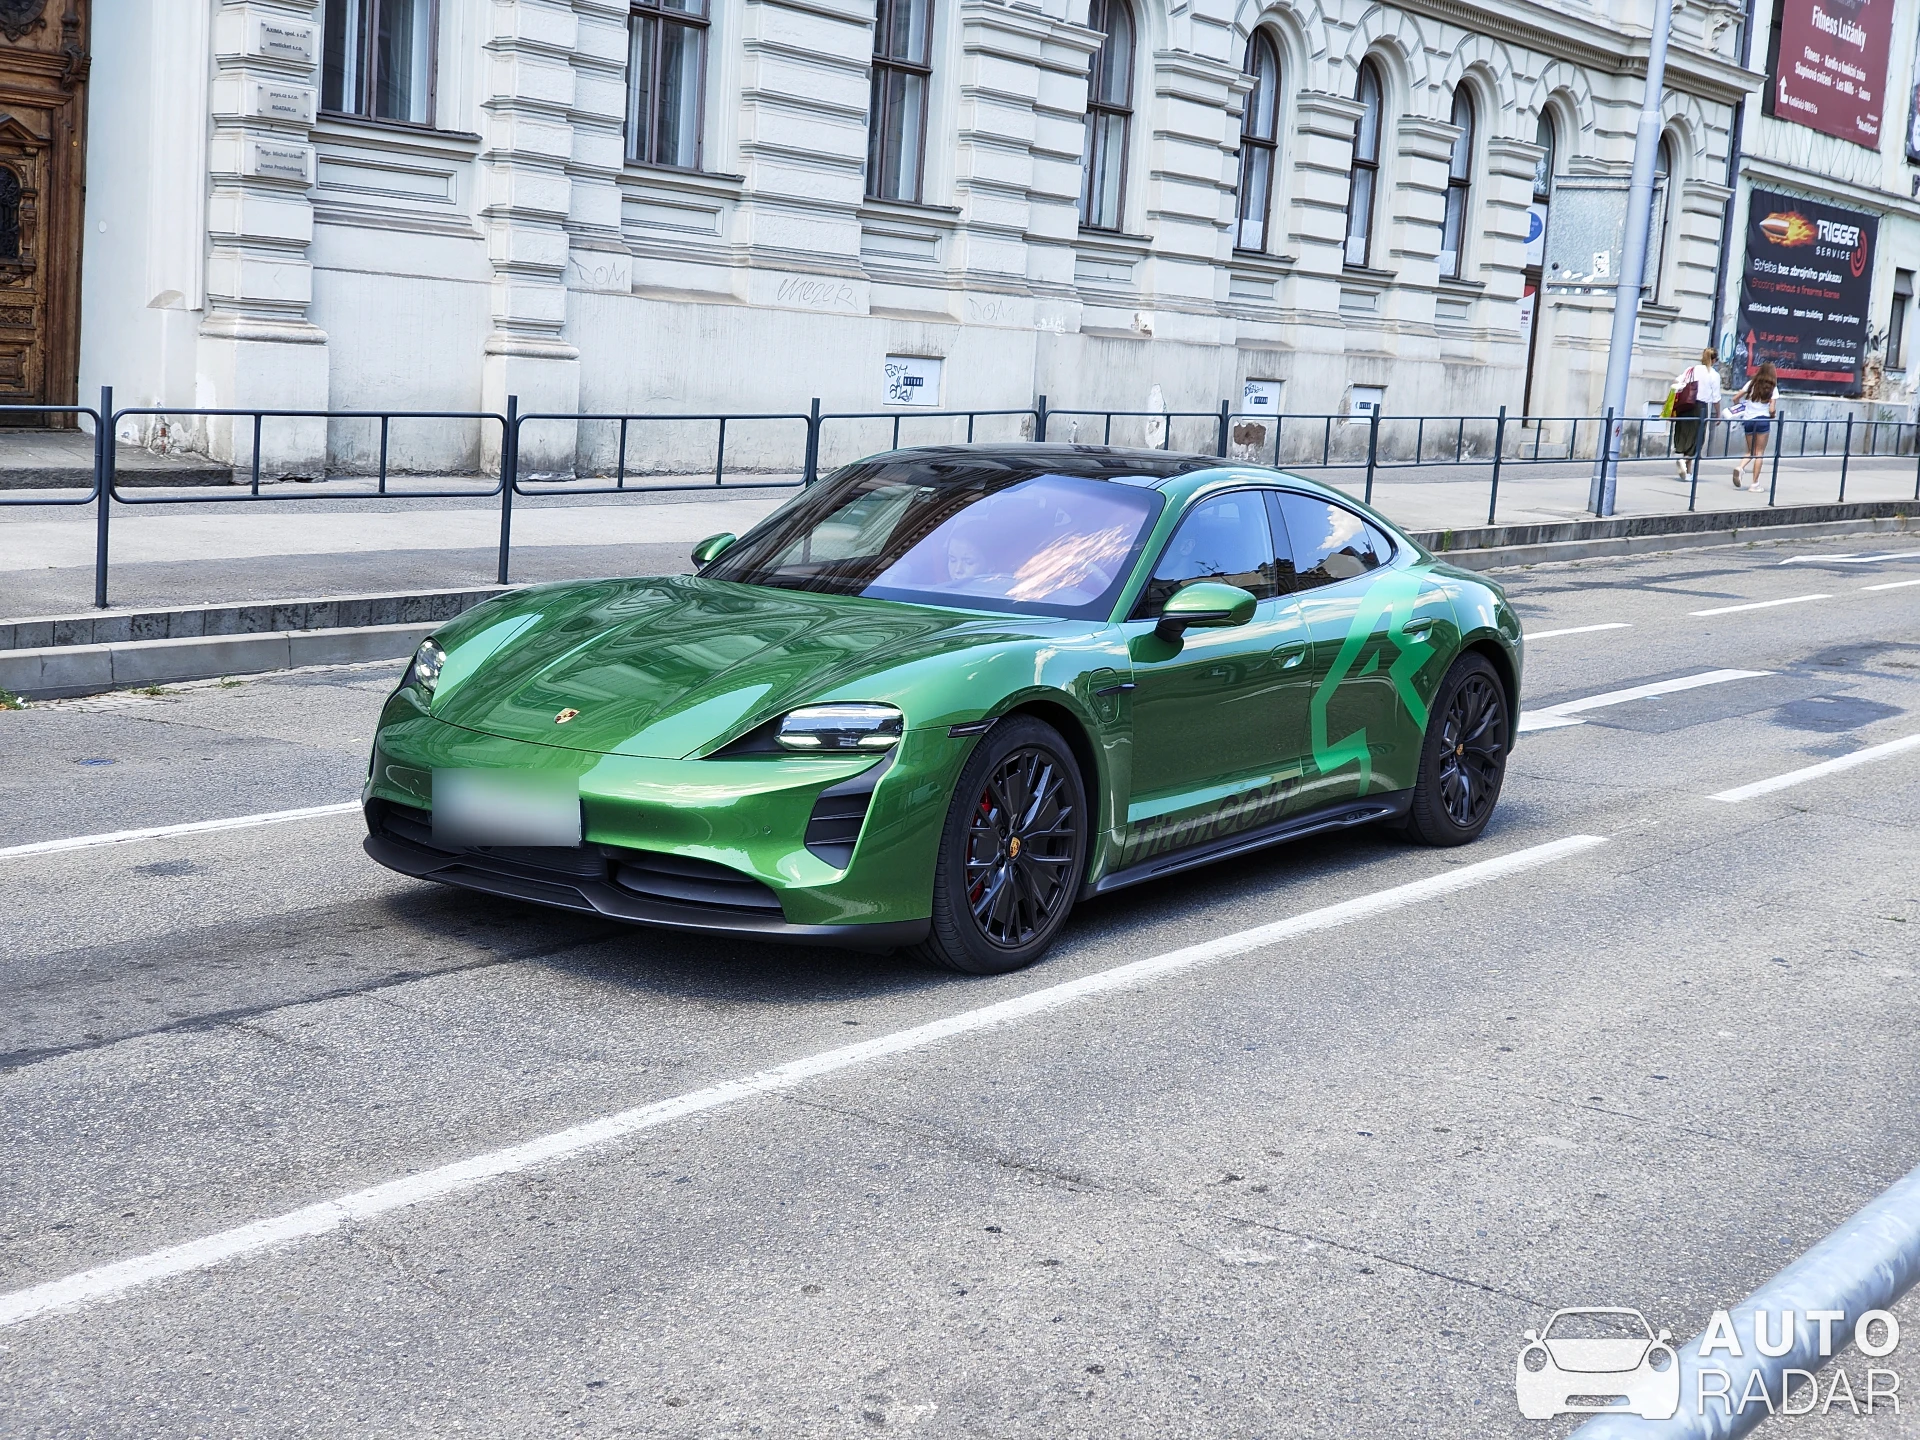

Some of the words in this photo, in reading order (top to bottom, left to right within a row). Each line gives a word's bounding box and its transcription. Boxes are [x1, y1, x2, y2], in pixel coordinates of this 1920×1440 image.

[1812, 5, 1838, 36] Fitness
[1838, 17, 1867, 52] Lužánky
[1804, 45, 1820, 63] Fitness
[1825, 54, 1838, 71] Kardio
[1836, 77, 1844, 92] Les
[1844, 81, 1854, 95] Mills
[1858, 86, 1871, 102] Sauna
[1816, 219, 1859, 247] TRIGGER
[1815, 246, 1851, 260] SERVICE
[1753, 258, 1777, 274] Střelba
[1778, 263, 1789, 275] bez
[1789, 265, 1817, 280] zbrojního
[1818, 269, 1842, 283] průkazu
[1752, 278, 1775, 292] Shooting
[1775, 282, 1796, 293] without
[1801, 285, 1822, 297] firearms
[1793, 308, 1805, 317] team
[1806, 309, 1824, 321] building
[1846, 339, 1857, 349] Brno
[1802, 351, 1856, 365] www.triggerservice.cz
[1130, 776, 1299, 862] TitanGOAT
